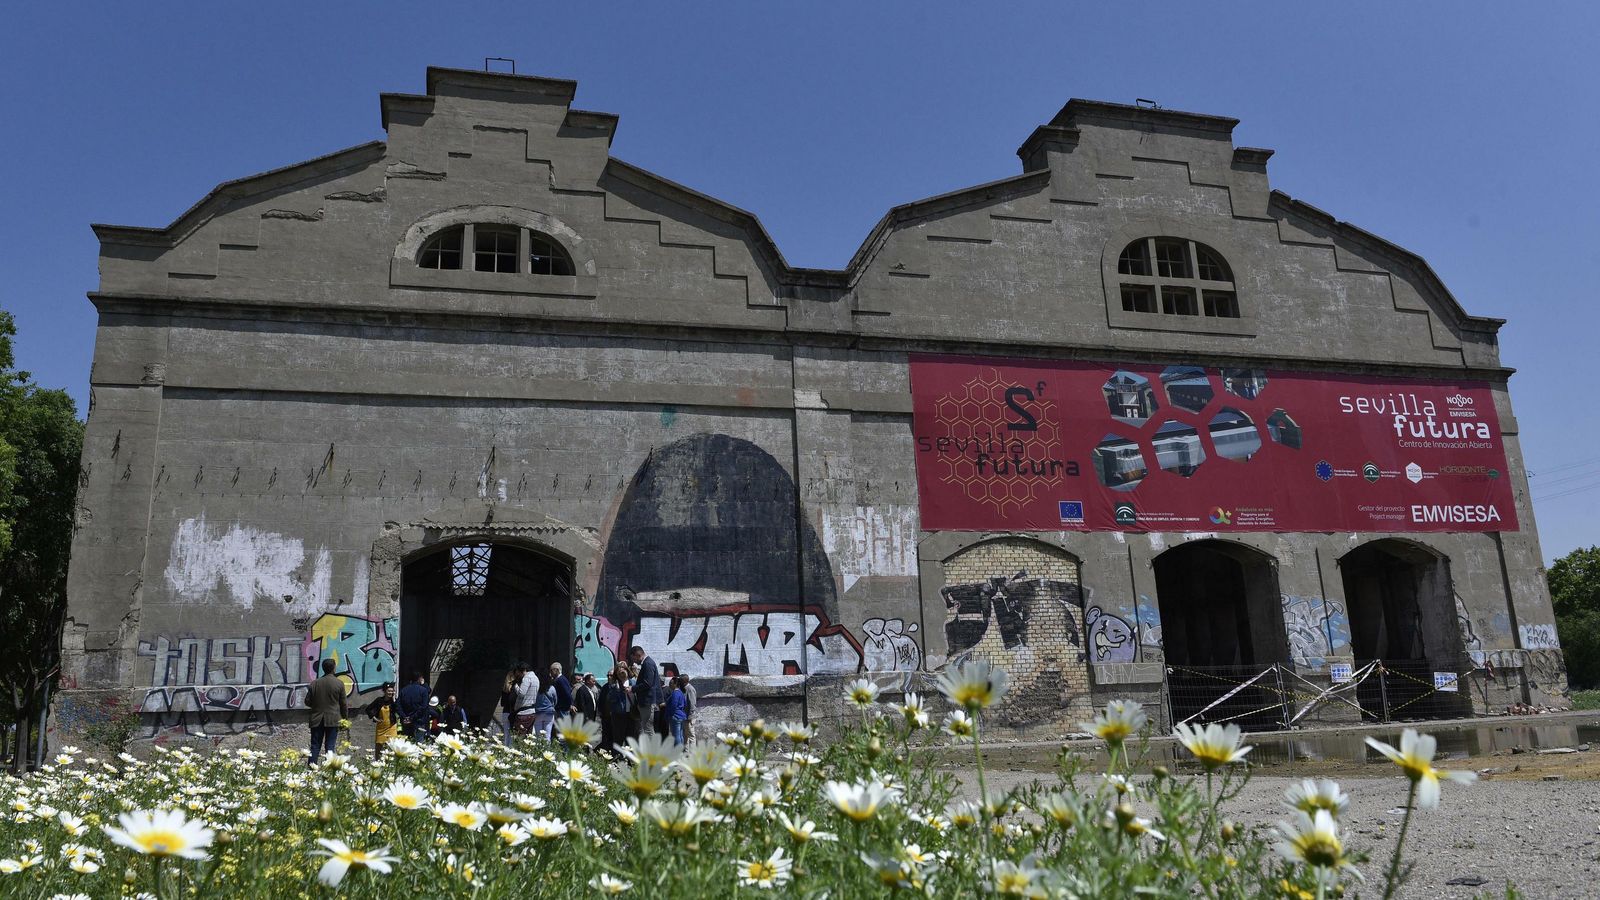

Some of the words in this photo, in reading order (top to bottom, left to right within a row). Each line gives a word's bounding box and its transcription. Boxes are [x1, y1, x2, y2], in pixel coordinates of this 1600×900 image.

[1339, 393, 1437, 417] sevilla
[1393, 414, 1491, 439] futura
[918, 432, 1025, 454] sevilla
[1398, 439, 1422, 448] Centro
[1422, 440, 1432, 448] de
[1468, 441, 1493, 449] Abierta
[976, 453, 1080, 477] futura
[1439, 465, 1486, 474] HORIZONTE
[1411, 504, 1501, 523] EMVISESA
[1526, 627, 1548, 637] VIVA
